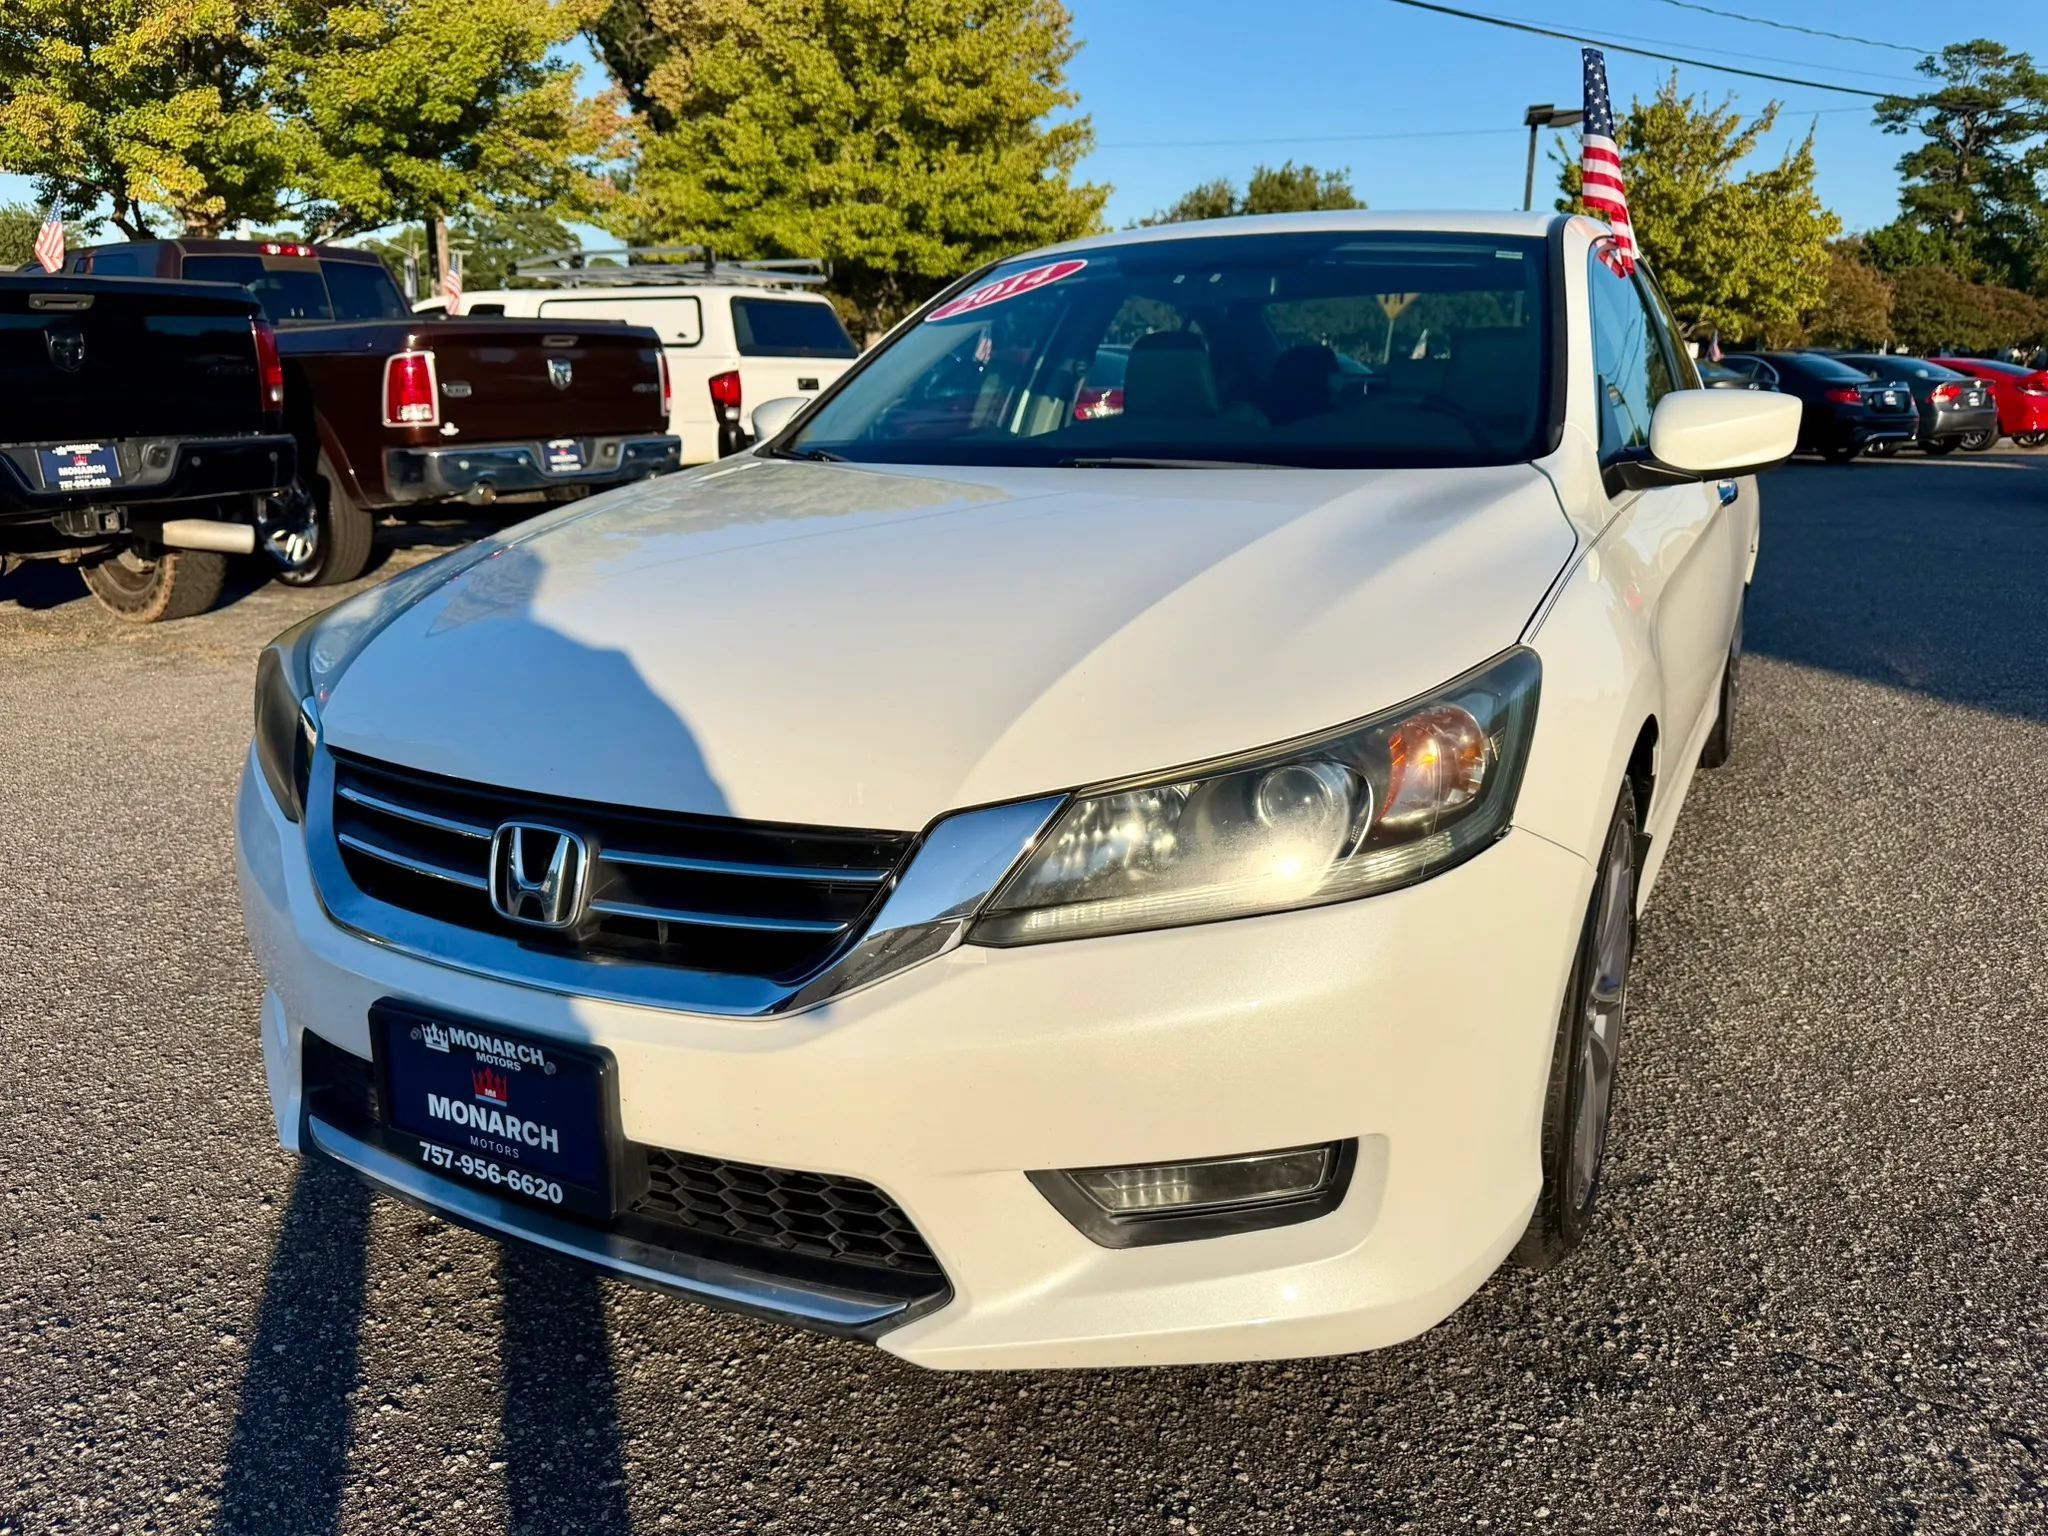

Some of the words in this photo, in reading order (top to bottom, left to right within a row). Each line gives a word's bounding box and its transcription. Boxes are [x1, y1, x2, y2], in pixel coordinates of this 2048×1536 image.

[950, 265, 1058, 313] 2014
[449, 1027, 545, 1066] MONARCH
[476, 1051, 521, 1071] MOTORS
[428, 1093, 559, 1153] MONARCH
[470, 1135, 519, 1159] MOTORS
[419, 1141, 563, 1204] 757-956-6620
